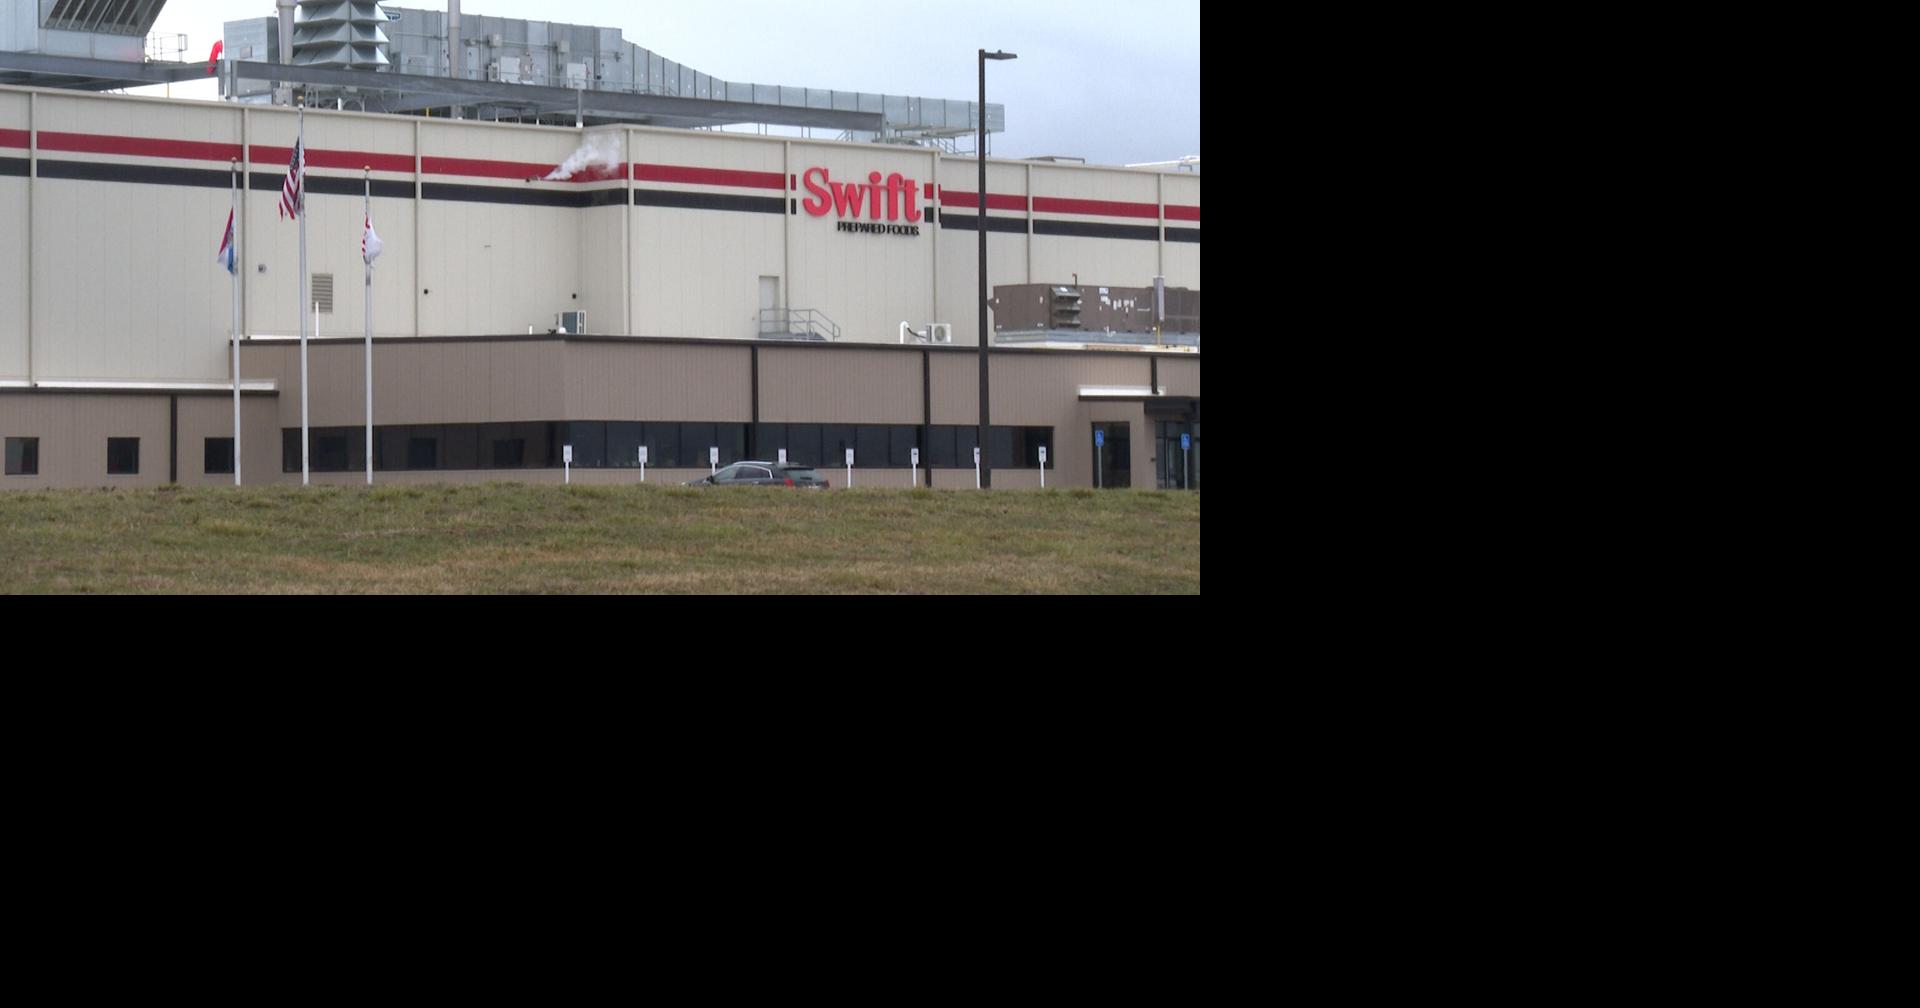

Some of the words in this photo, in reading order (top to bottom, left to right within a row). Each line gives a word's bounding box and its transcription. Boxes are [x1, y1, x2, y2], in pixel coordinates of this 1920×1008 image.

[802, 167, 921, 223] Swift
[837, 221, 886, 235] PREPARED
[886, 224, 920, 237] FOODS
